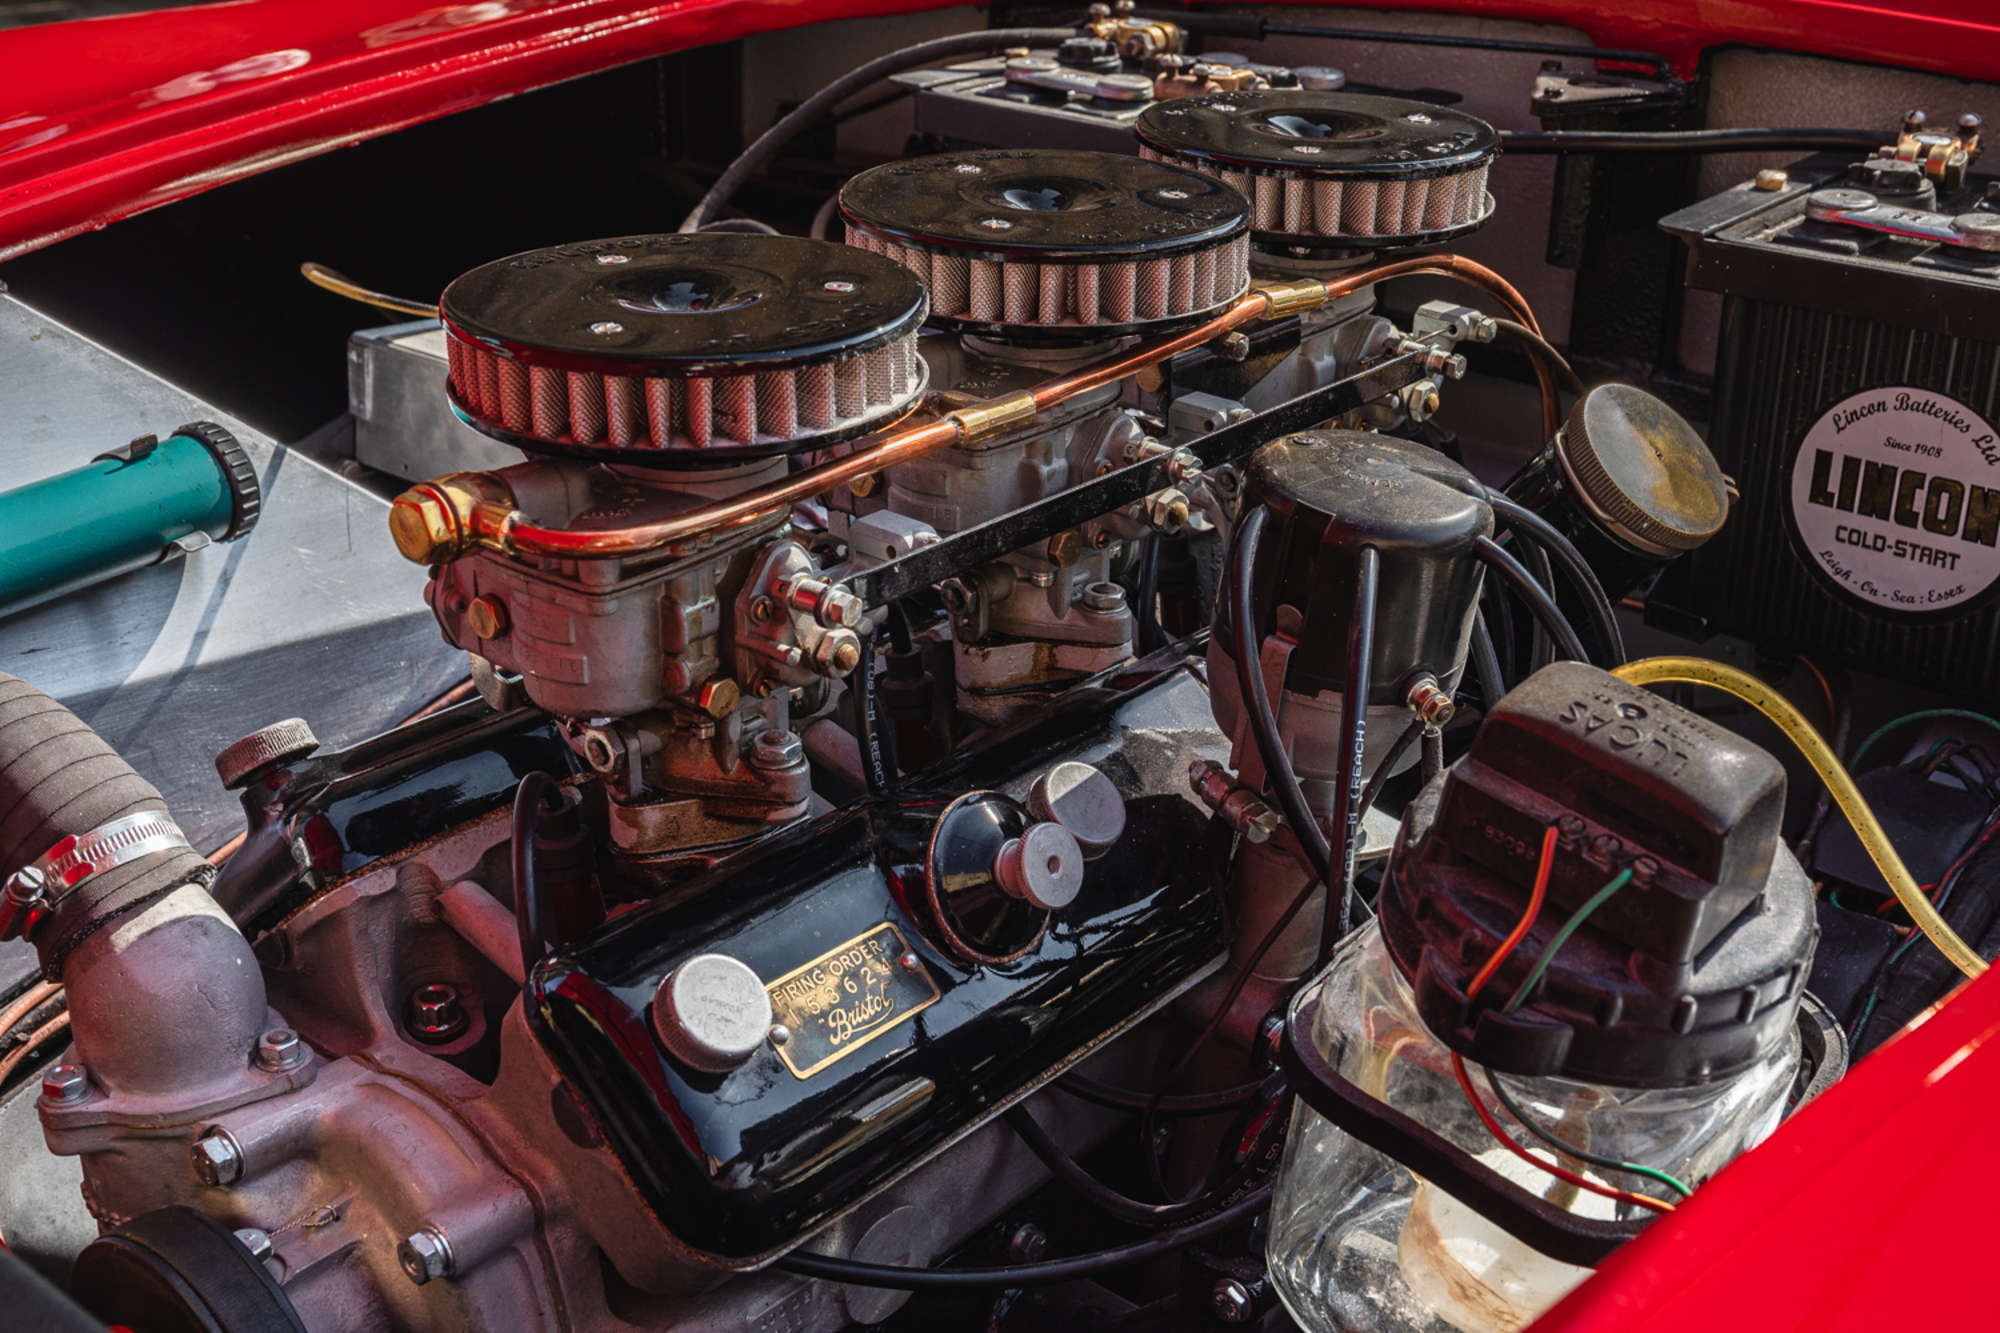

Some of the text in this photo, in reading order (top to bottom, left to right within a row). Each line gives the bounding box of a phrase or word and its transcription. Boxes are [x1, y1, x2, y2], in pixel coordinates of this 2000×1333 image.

[1832, 393, 2000, 466] Lincon Batteries Ltd
[1884, 436, 1943, 458] Since 1908
[1809, 449, 2000, 547] LINCON
[1819, 549, 1851, 581] Leigh
[1860, 580, 1878, 597] On
[1890, 591, 1915, 604] Sea
[1928, 585, 1966, 604] Essex
[1835, 525, 1961, 571] COLD-START
[1350, 719, 1367, 800] (REACH)
[1559, 701, 1689, 777] LUCAS
[772, 941, 883, 1007] FIRING ORDER
[807, 999, 821, 1015] 5
[825, 986, 840, 1004] 3
[843, 976, 858, 994] 6
[860, 966, 877, 984] 2
[828, 981, 893, 1043] Bristol
